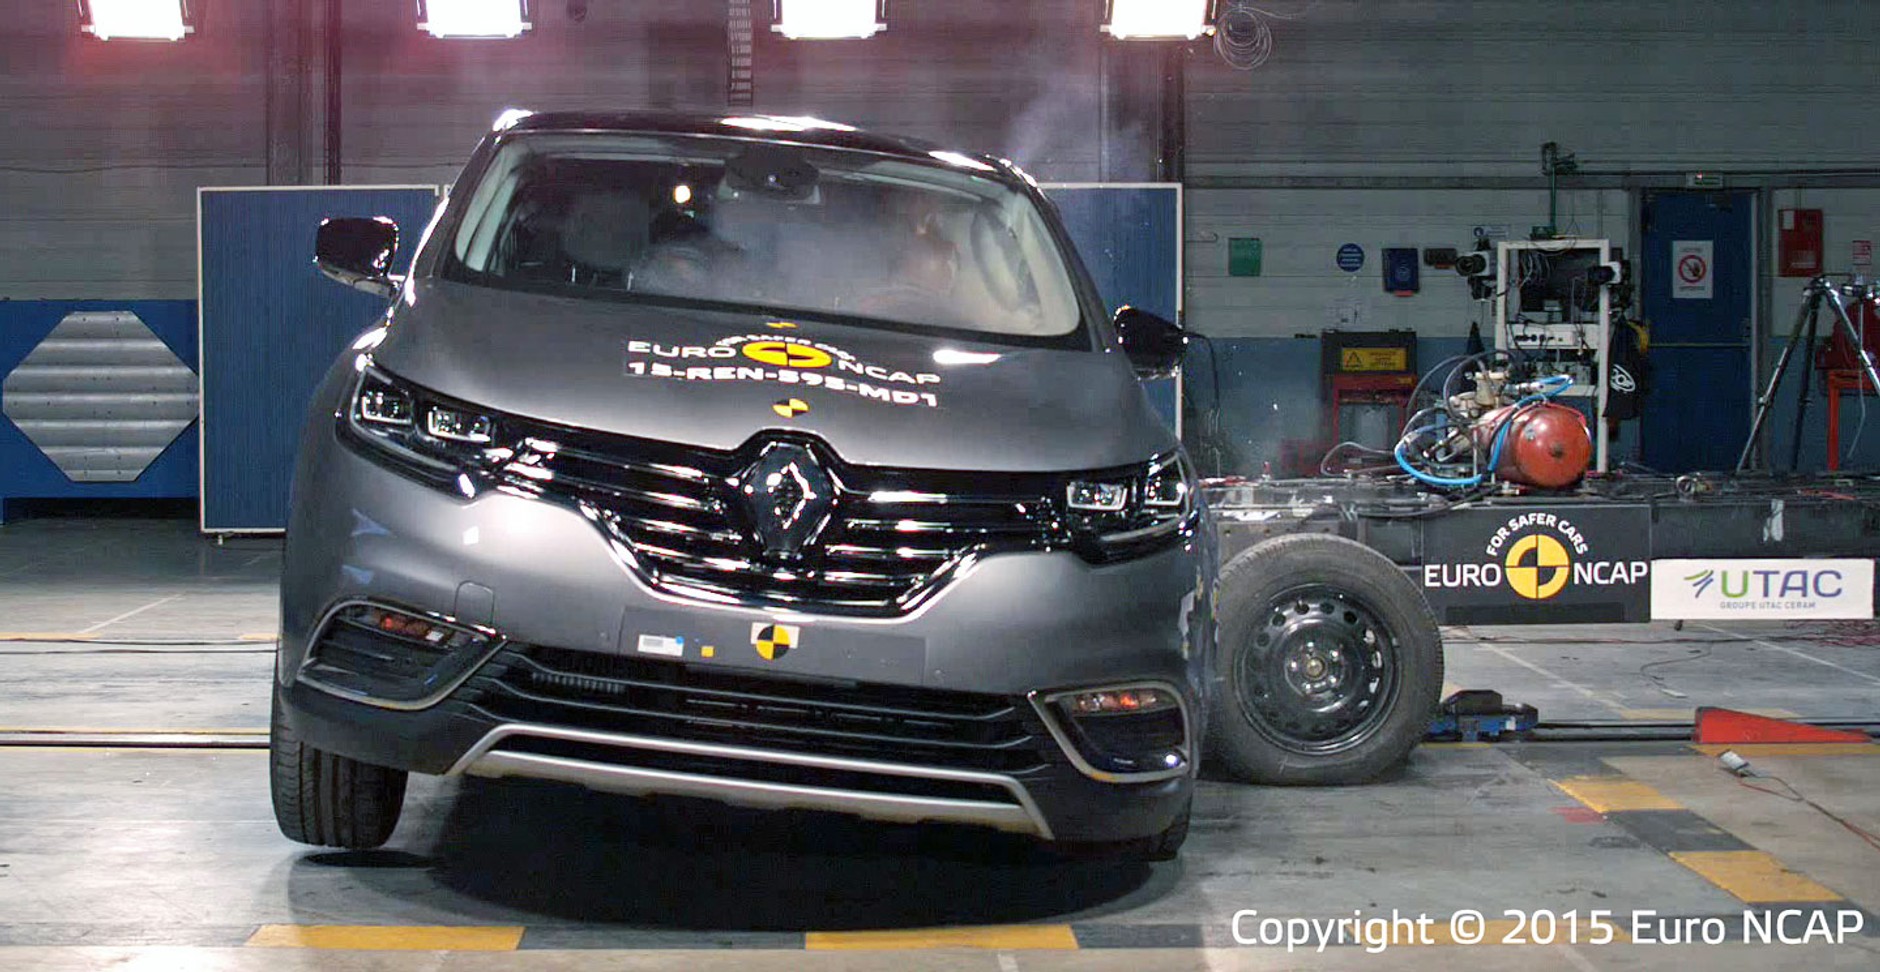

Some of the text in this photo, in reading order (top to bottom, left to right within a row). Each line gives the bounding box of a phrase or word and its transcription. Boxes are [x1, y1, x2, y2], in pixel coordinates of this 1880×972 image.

[627, 340, 941, 385] EURO NCAP
[1485, 512, 1589, 557] FOR SAFER CARS
[1424, 561, 1648, 588] EURO NCAP
[1721, 569, 1842, 599] UTAC
[1720, 601, 1816, 610] GROUPE UTAC CERAM
